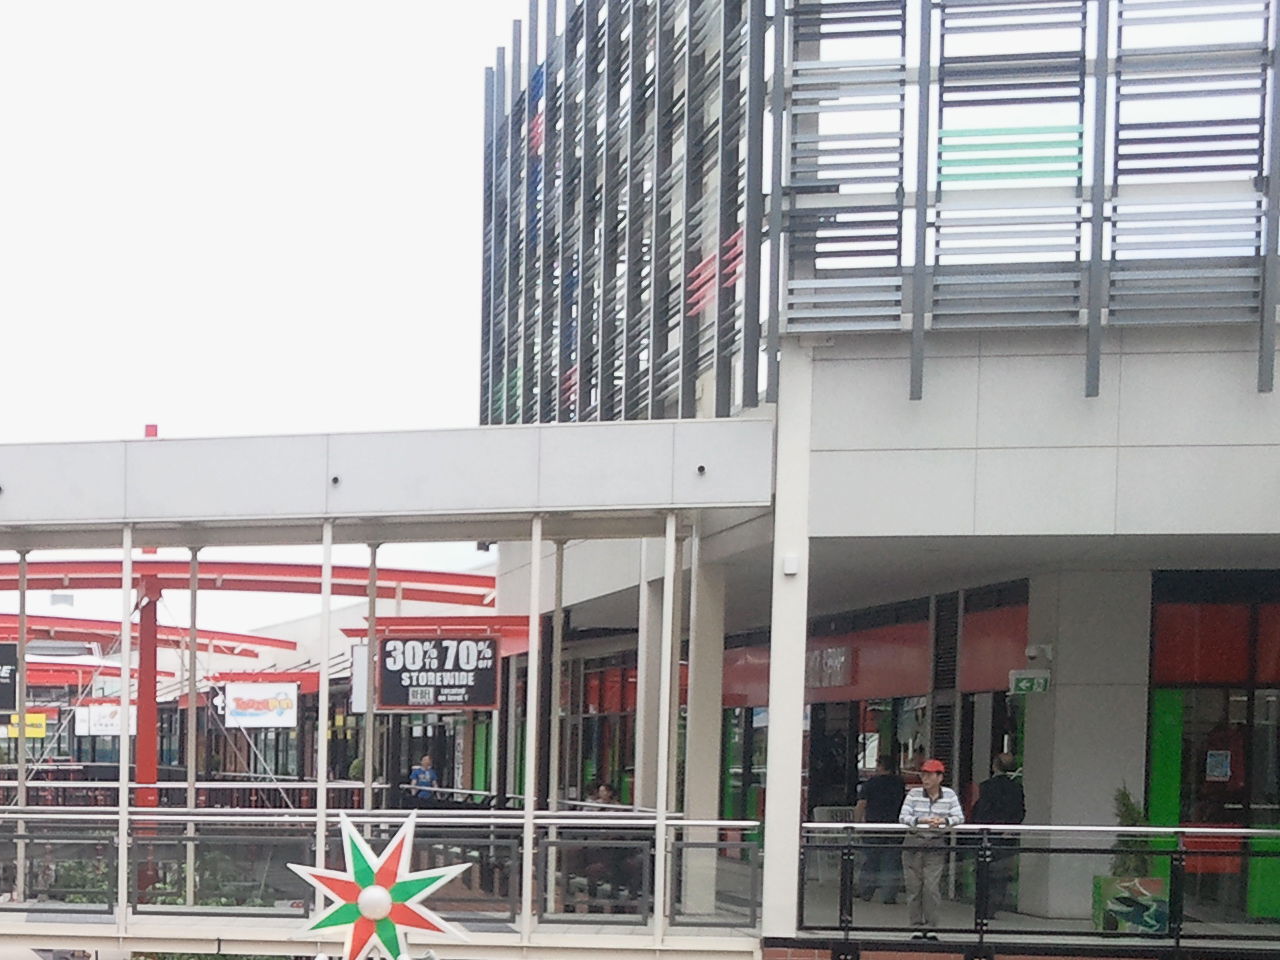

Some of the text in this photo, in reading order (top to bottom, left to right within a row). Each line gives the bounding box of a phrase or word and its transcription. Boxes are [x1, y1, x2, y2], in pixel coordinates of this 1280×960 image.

[385, 640, 438, 671] 30%
[442, 640, 492, 670] 70%
[401, 671, 475, 686] STOREWIDE
